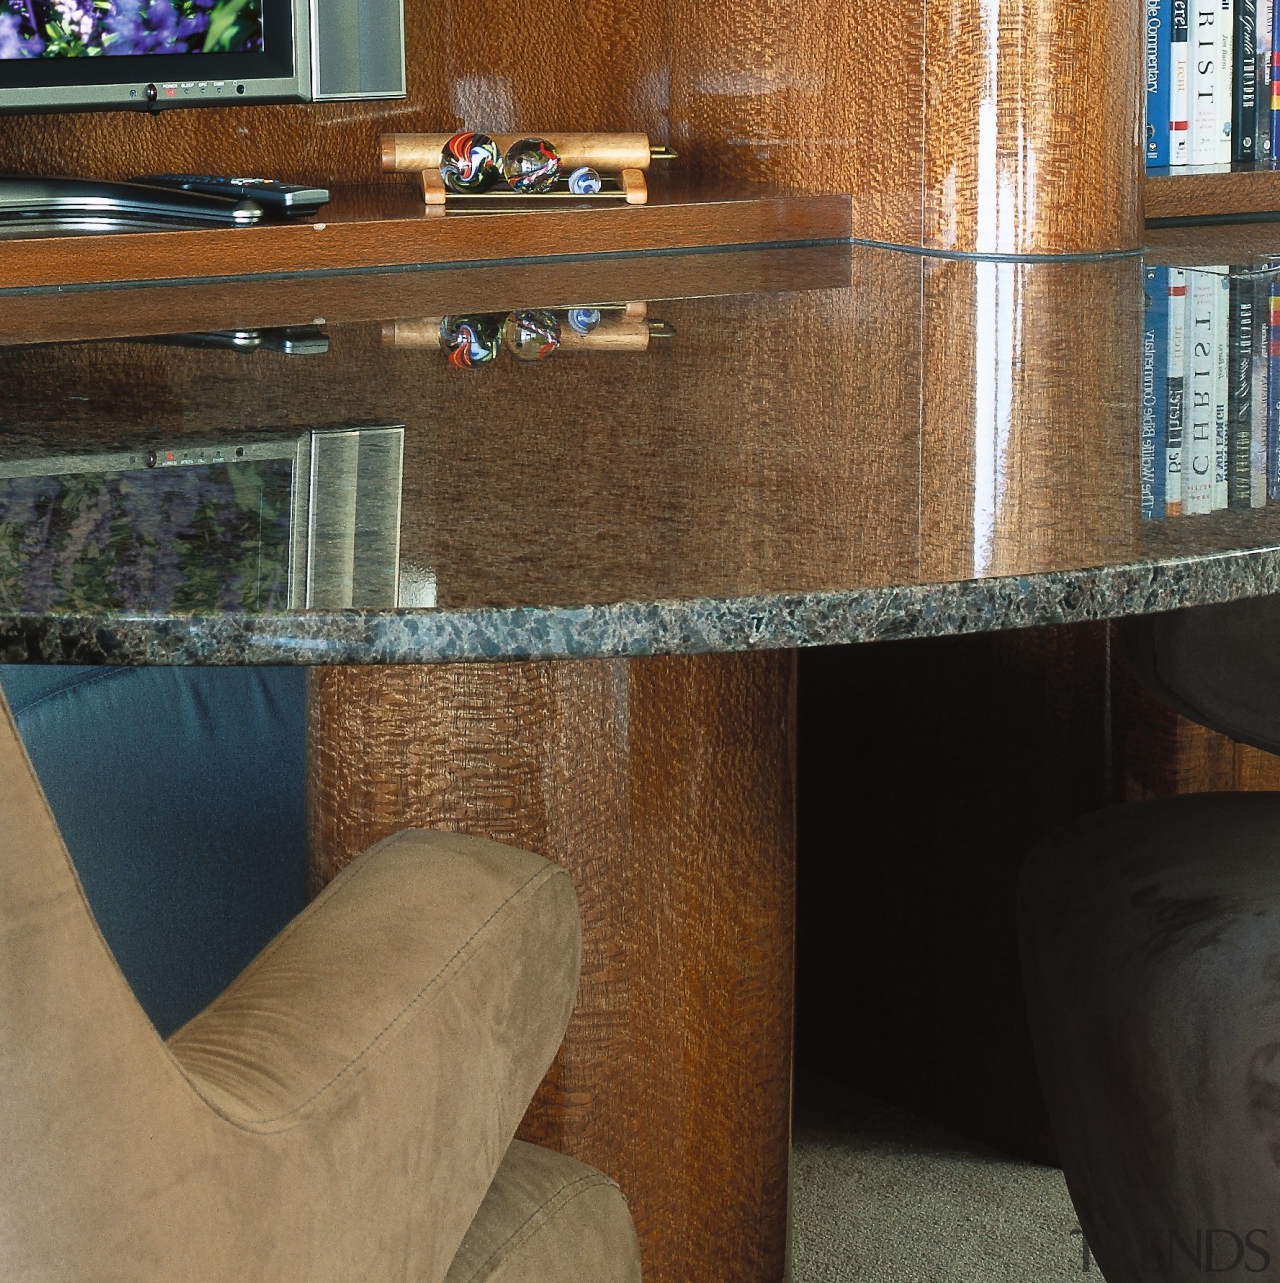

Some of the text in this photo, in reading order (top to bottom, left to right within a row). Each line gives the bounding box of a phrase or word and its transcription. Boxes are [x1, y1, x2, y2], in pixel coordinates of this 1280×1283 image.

[1147, 18, 1162, 94] Commentary
[1238, 15, 1255, 55] Gentle
[1178, 60, 1186, 93] Trent
[1243, 58, 1255, 108] THUNDER
